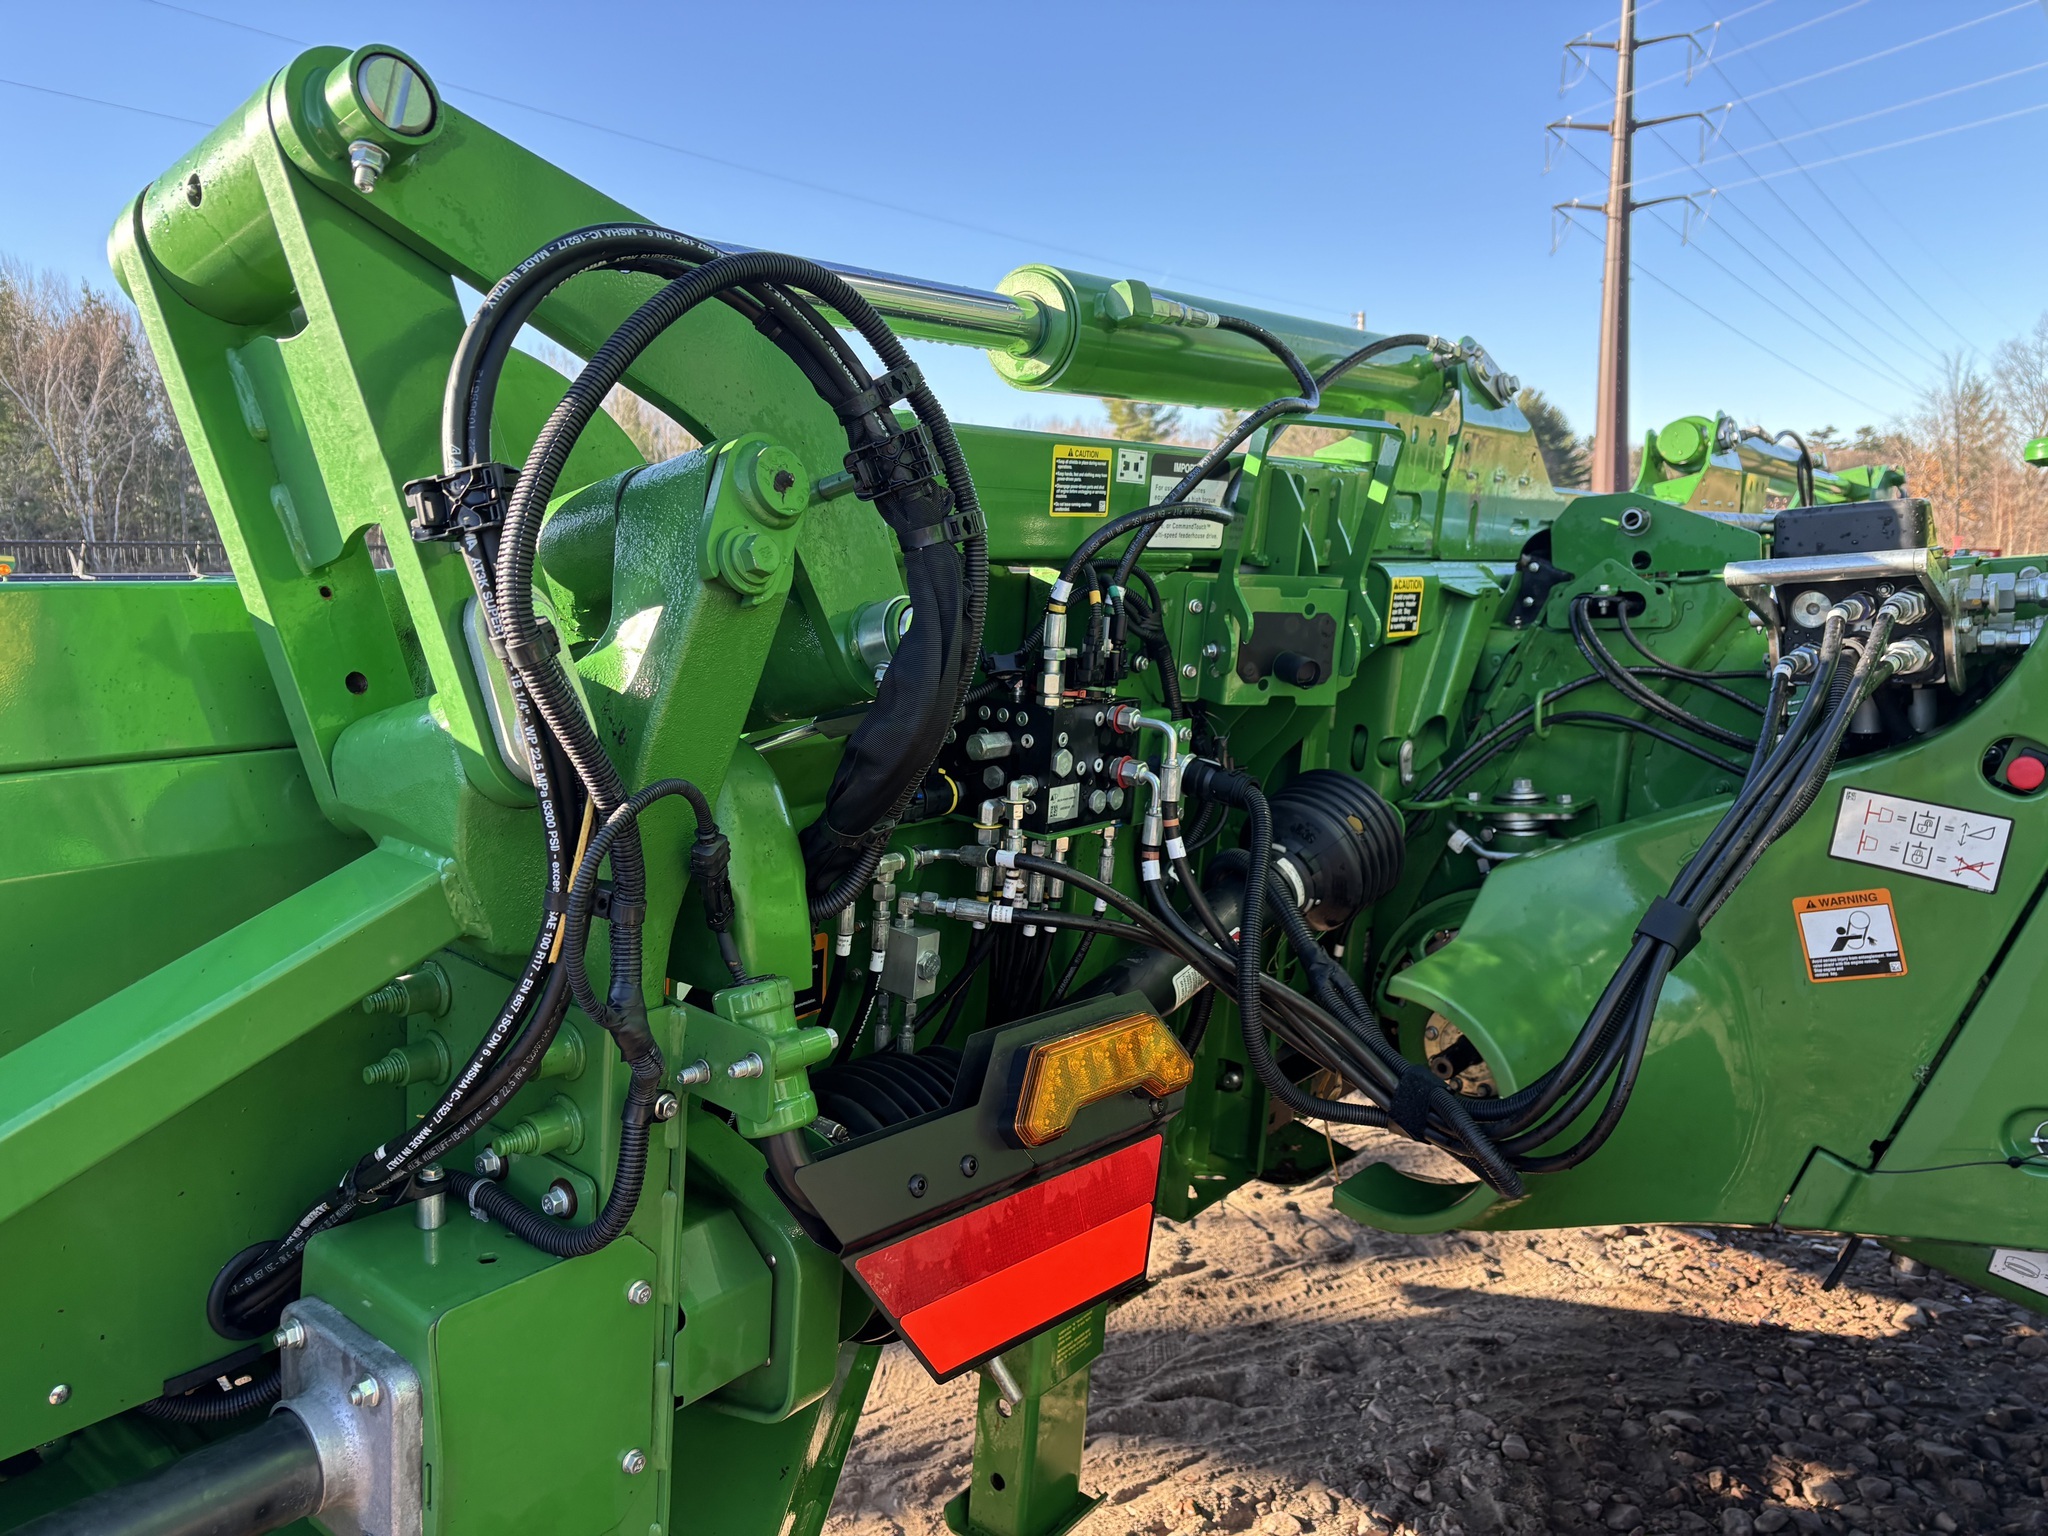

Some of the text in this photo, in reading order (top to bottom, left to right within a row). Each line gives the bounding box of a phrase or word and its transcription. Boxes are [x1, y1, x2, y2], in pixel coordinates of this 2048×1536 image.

[558, 230, 602, 251] IC-152/7
[606, 228, 638, 238] MSHA
[654, 230, 672, 240] DN
[674, 234, 694, 246] 1SC
[522, 249, 550, 276] MADE
[508, 270, 522, 284] IN
[486, 280, 512, 309] ITALY
[1074, 450, 1099, 458] CAUTION
[471, 556, 490, 588] AT3K
[1398, 580, 1422, 590] CAUTION
[482, 590, 507, 638] SUPER
[510, 672, 524, 688] 1B
[515, 690, 532, 716] 1/4"
[524, 726, 538, 746] WP
[529, 747, 544, 772] 22.5
[535, 772, 550, 798] MPa
[542, 800, 557, 828] (3300
[548, 830, 560, 852] PSI)
[552, 862, 560, 892] excee
[1818, 892, 1878, 907] WARNING
[540, 932, 553, 950] 100
[531, 950, 546, 972] R17
[522, 978, 534, 994] EN
[510, 994, 526, 1014] 857
[497, 1014, 514, 1034] 1SC
[486, 1033, 502, 1050] DN
[482, 1048, 492, 1057] 6
[456, 1062, 484, 1090] MSHA
[500, 1079, 516, 1098] 22.5
[434, 1088, 464, 1126] IC-152/7
[408, 1126, 434, 1150] MADE
[400, 1146, 413, 1160] IN
[386, 1155, 406, 1172] ITALY
